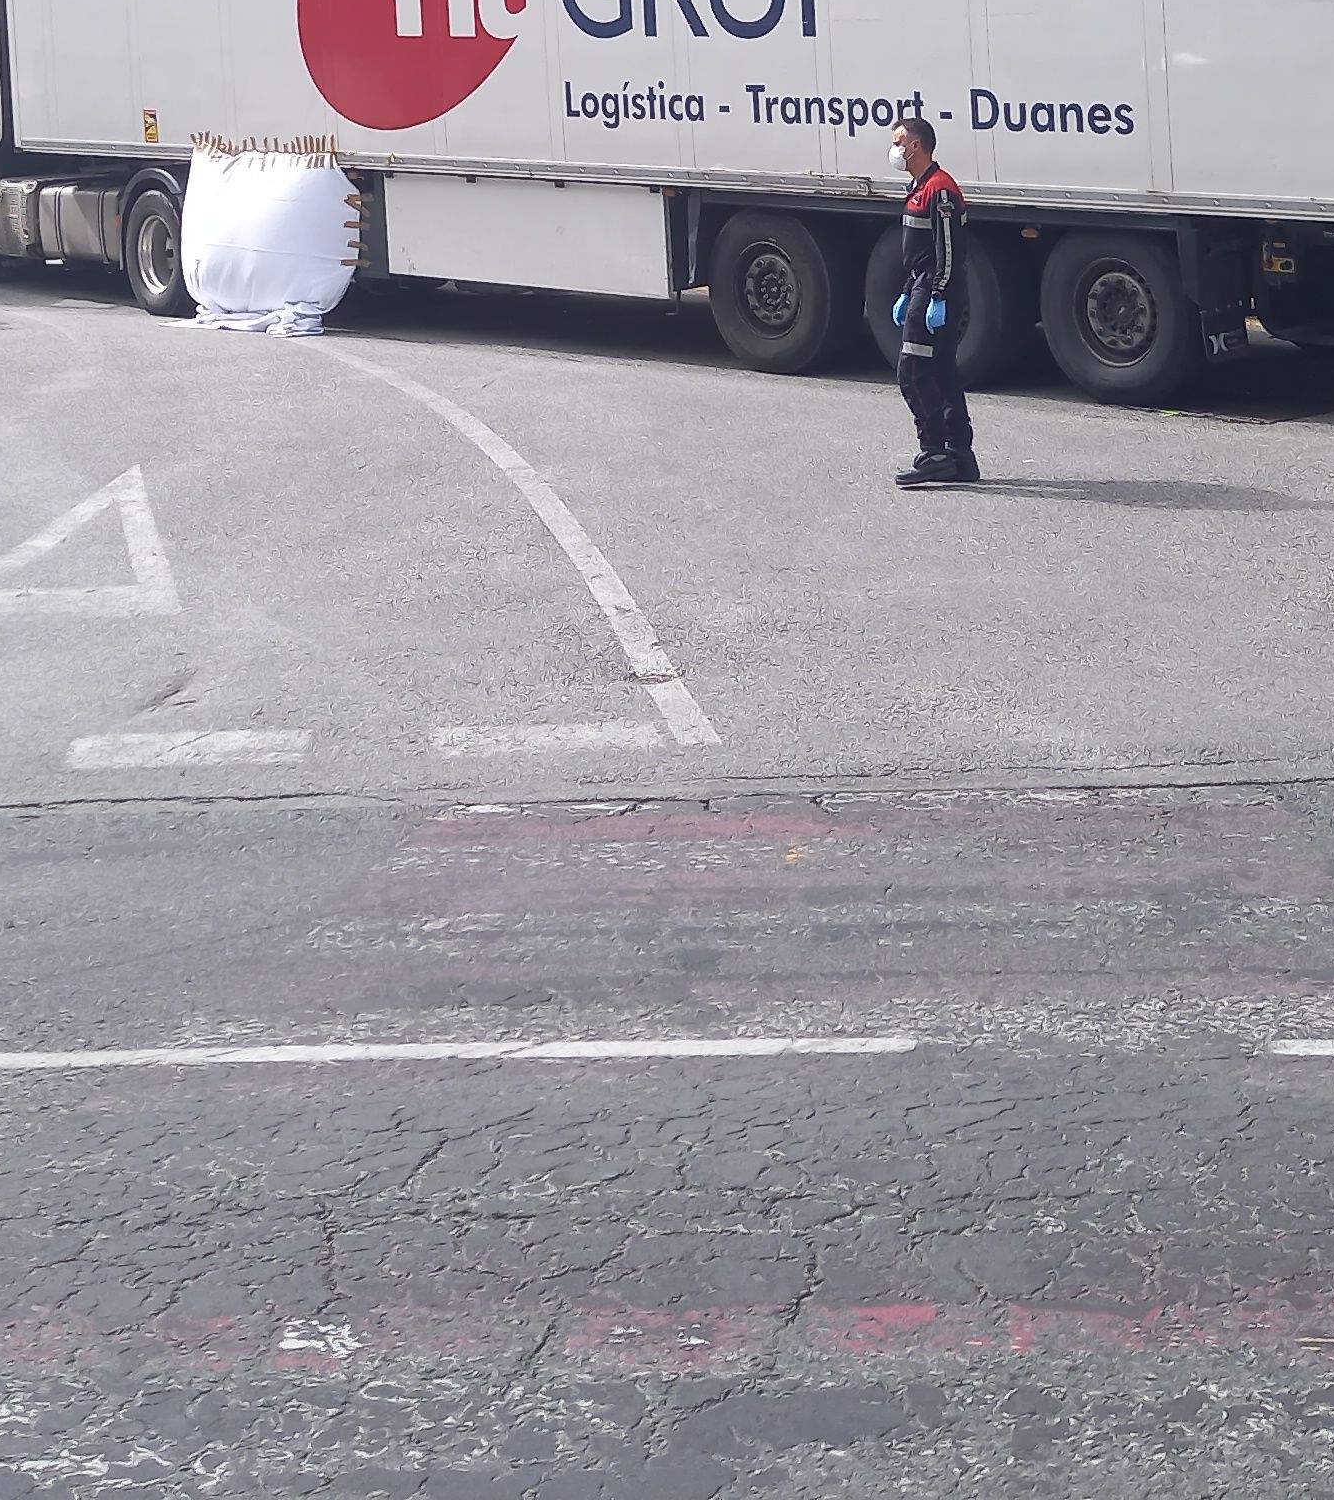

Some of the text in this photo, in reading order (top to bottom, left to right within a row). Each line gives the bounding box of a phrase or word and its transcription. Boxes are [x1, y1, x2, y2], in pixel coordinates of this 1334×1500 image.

[565, 80, 705, 129] Logística
[746, 84, 925, 137] Transport
[970, 88, 1135, 135] Duanes
